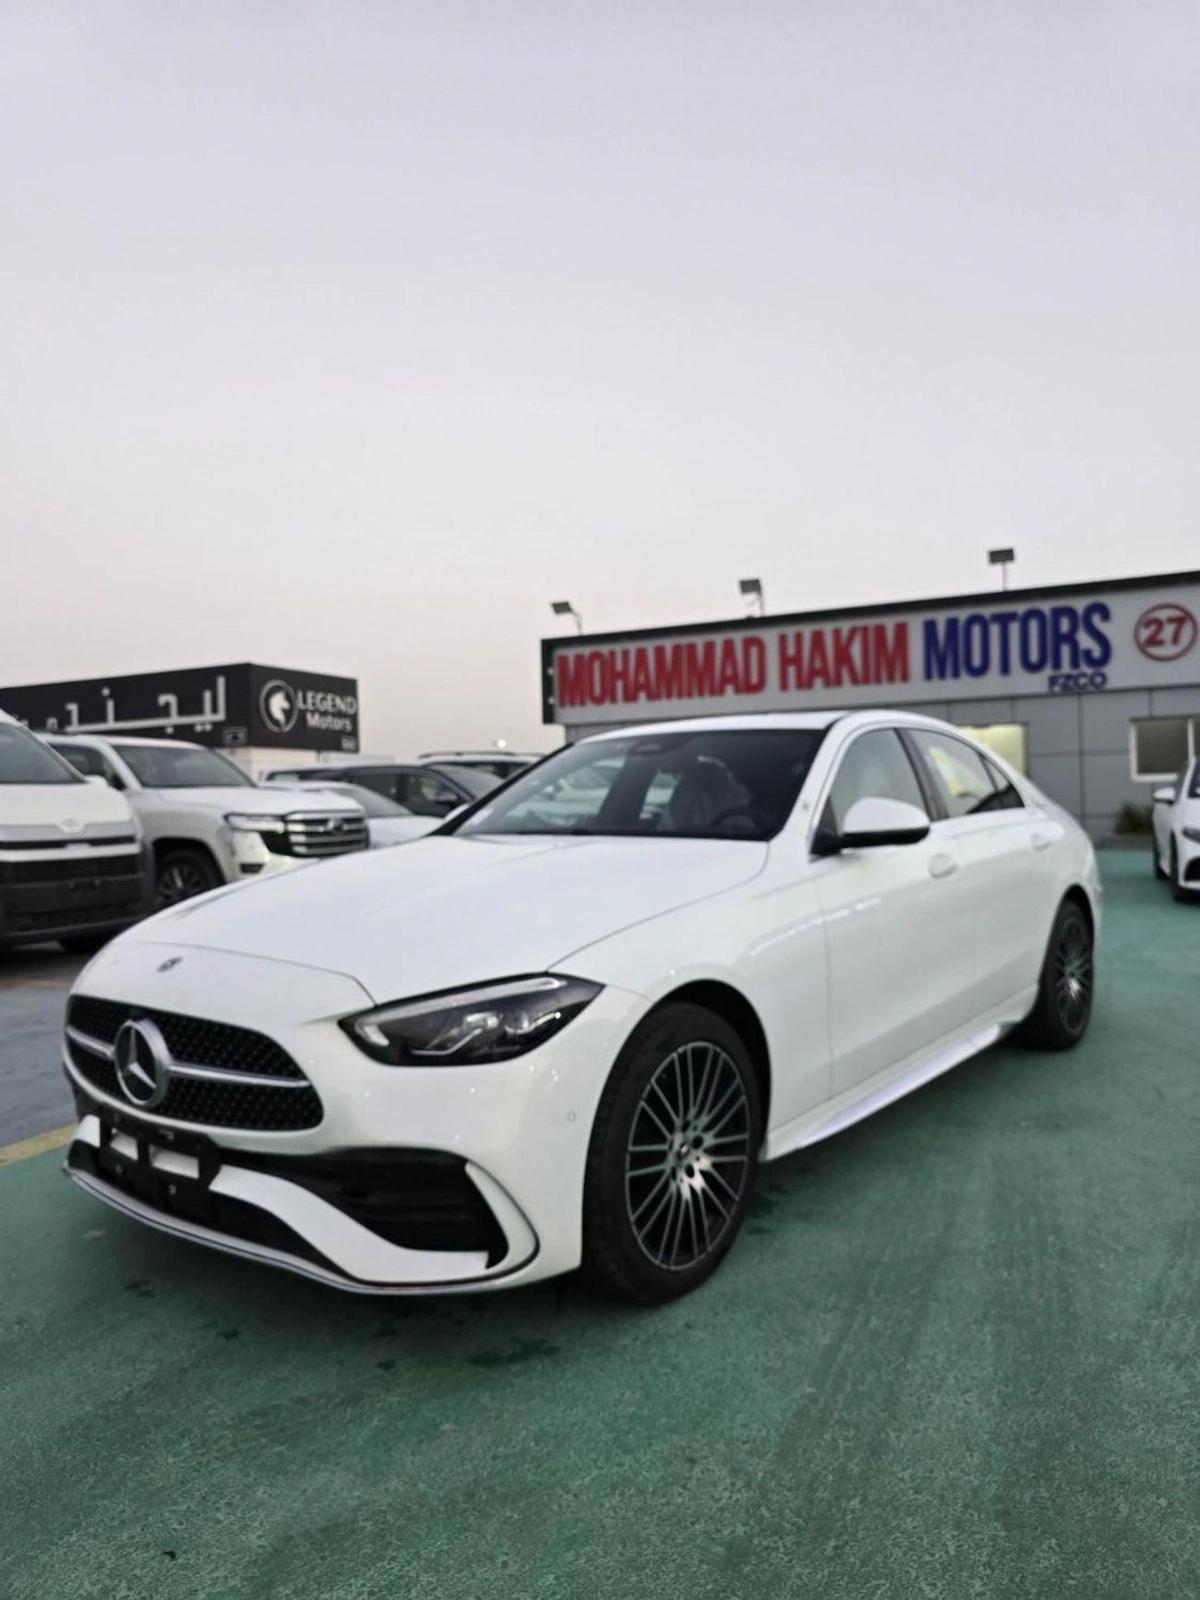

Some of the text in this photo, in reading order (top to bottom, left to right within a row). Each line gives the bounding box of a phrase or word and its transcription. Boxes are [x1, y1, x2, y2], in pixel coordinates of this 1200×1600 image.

[1142, 616, 1187, 647] 27
[558, 602, 1112, 706] MOHAMMAD HAKIM MOTORS
[1048, 670, 1108, 692] FZCO
[297, 690, 358, 715] LEGEND
[305, 711, 353, 733] Motors
